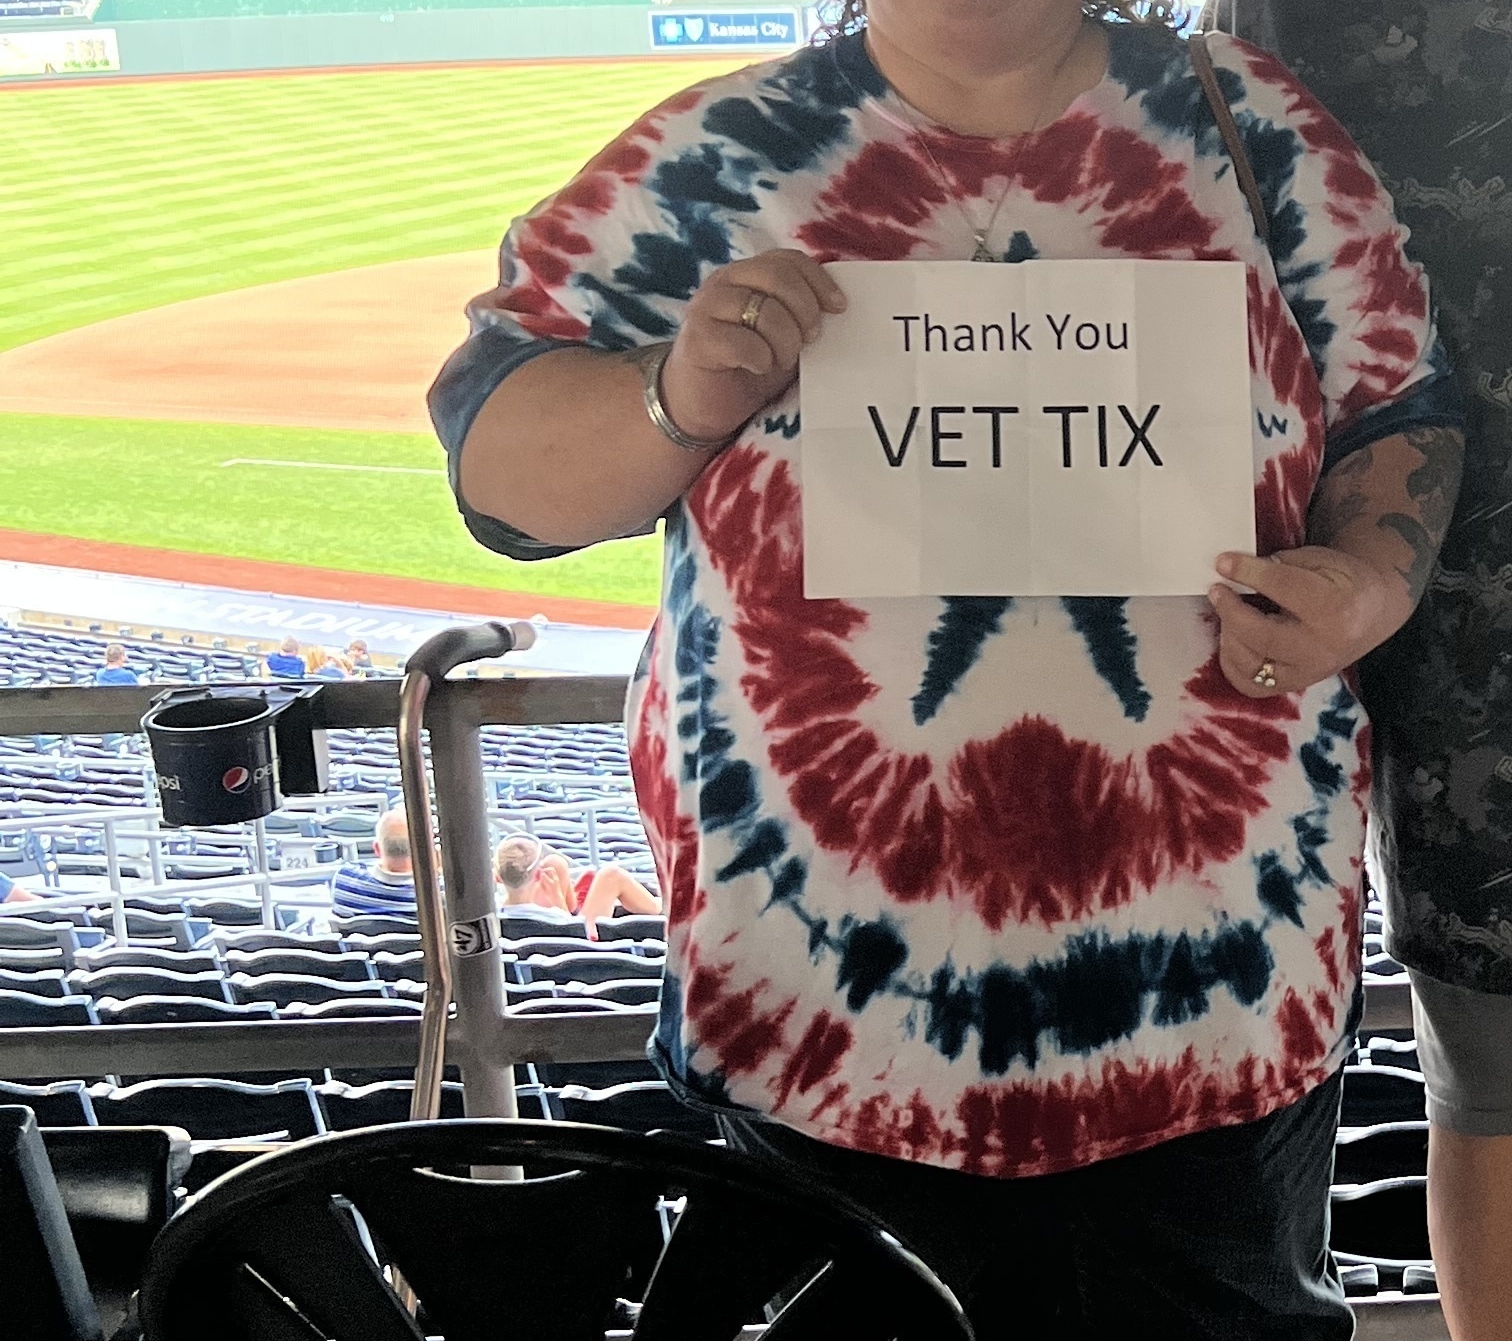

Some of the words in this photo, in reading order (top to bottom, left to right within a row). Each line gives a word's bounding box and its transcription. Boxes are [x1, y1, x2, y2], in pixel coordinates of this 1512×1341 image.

[709, 21, 760, 38] Kansas
[760, 20, 789, 39] City
[892, 311, 1034, 353] Thank
[1045, 313, 1130, 352] You
[866, 404, 1020, 469] VET
[1042, 403, 1164, 469] TIX
